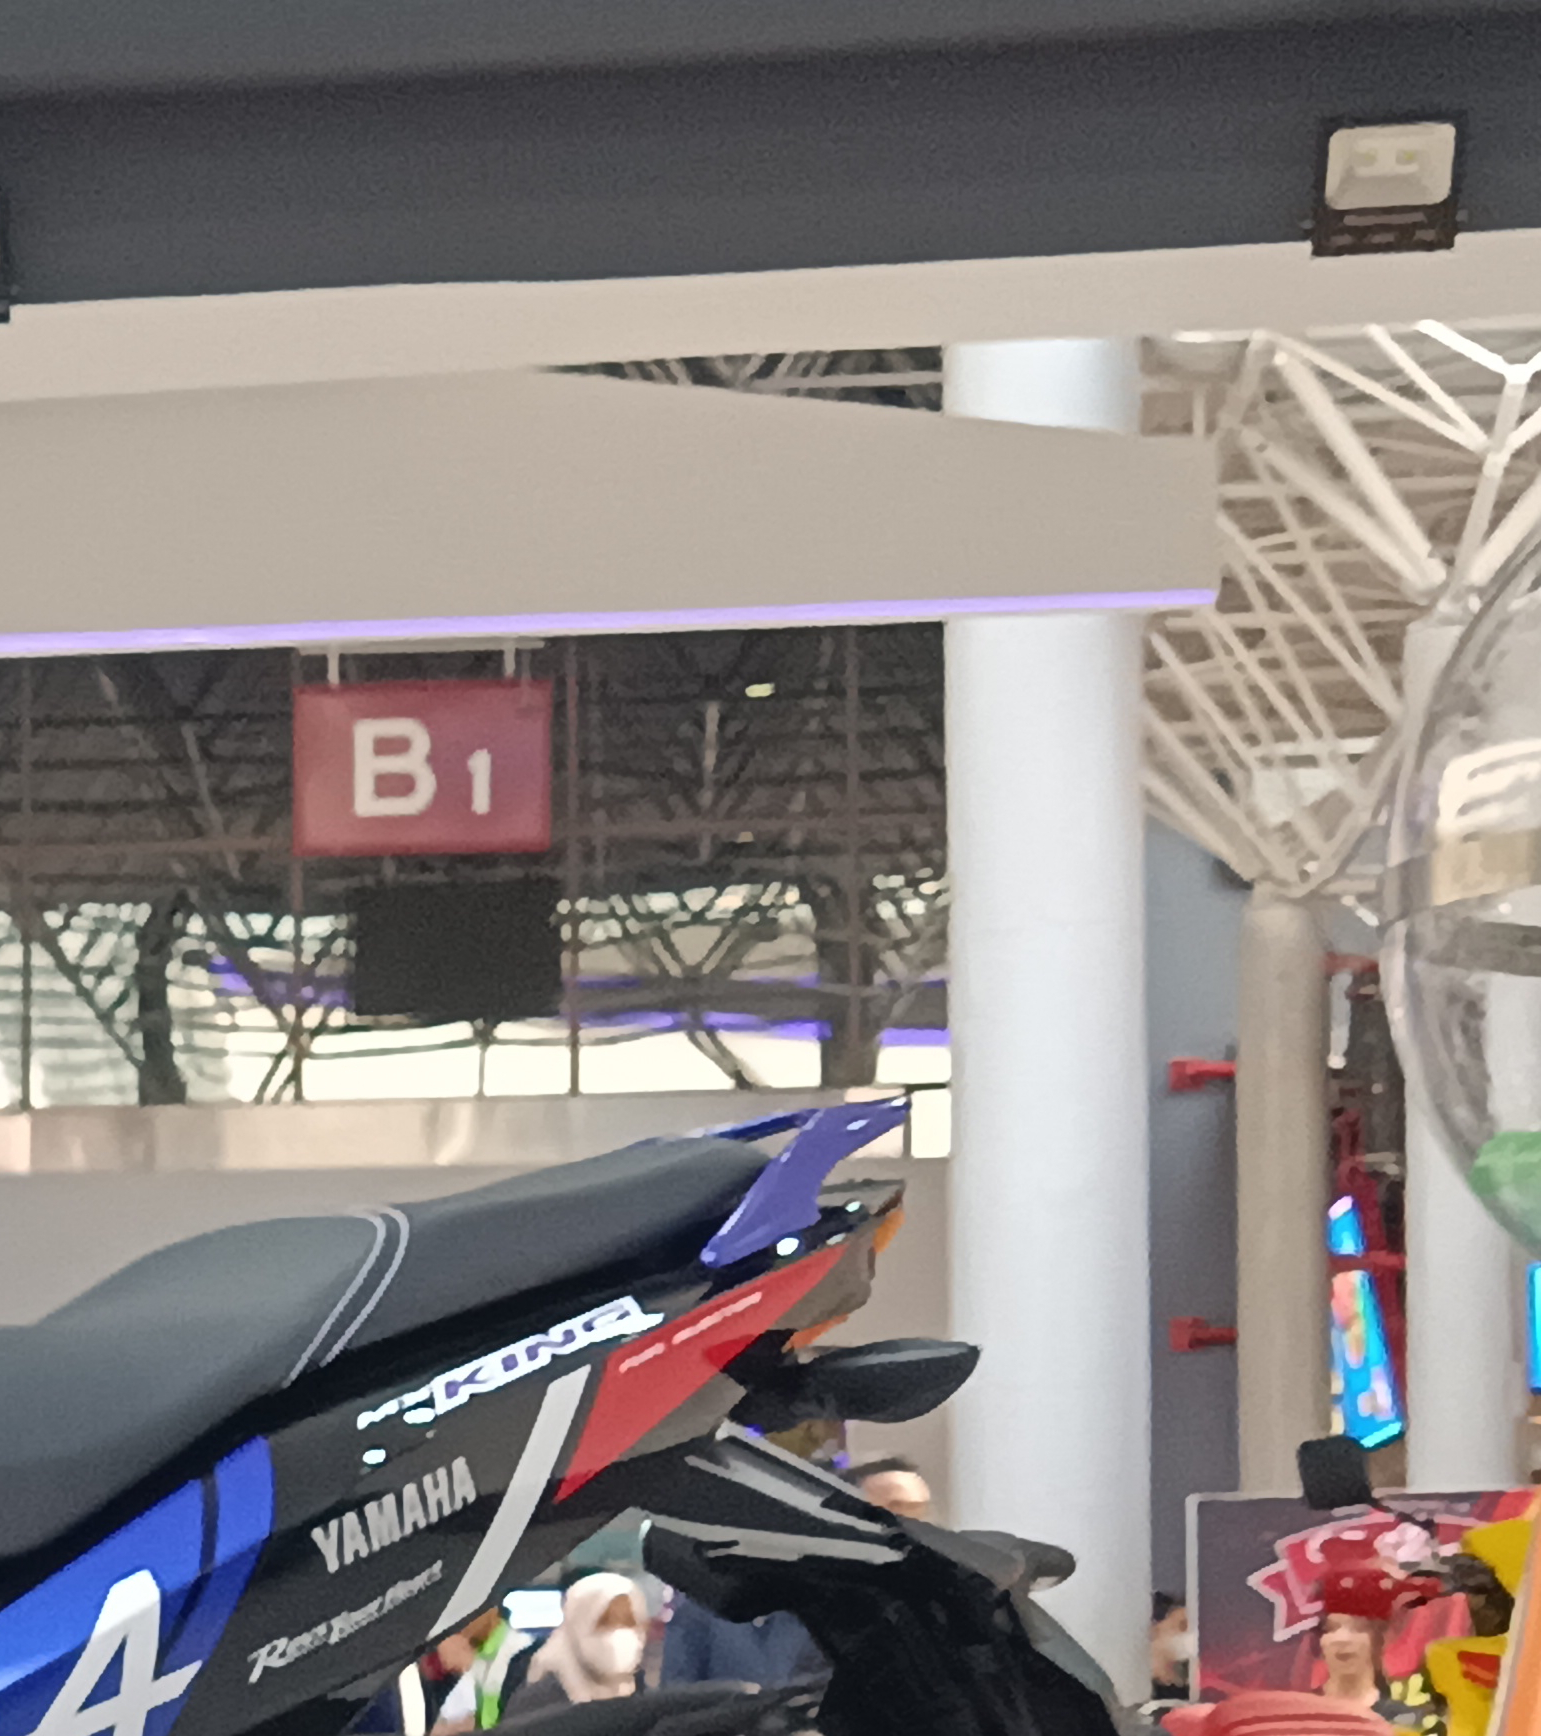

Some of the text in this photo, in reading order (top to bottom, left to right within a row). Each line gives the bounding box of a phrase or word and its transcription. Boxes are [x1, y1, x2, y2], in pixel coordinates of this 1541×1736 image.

[352, 716, 493, 818] B 1
[310, 1455, 477, 1575] YAMAHA
